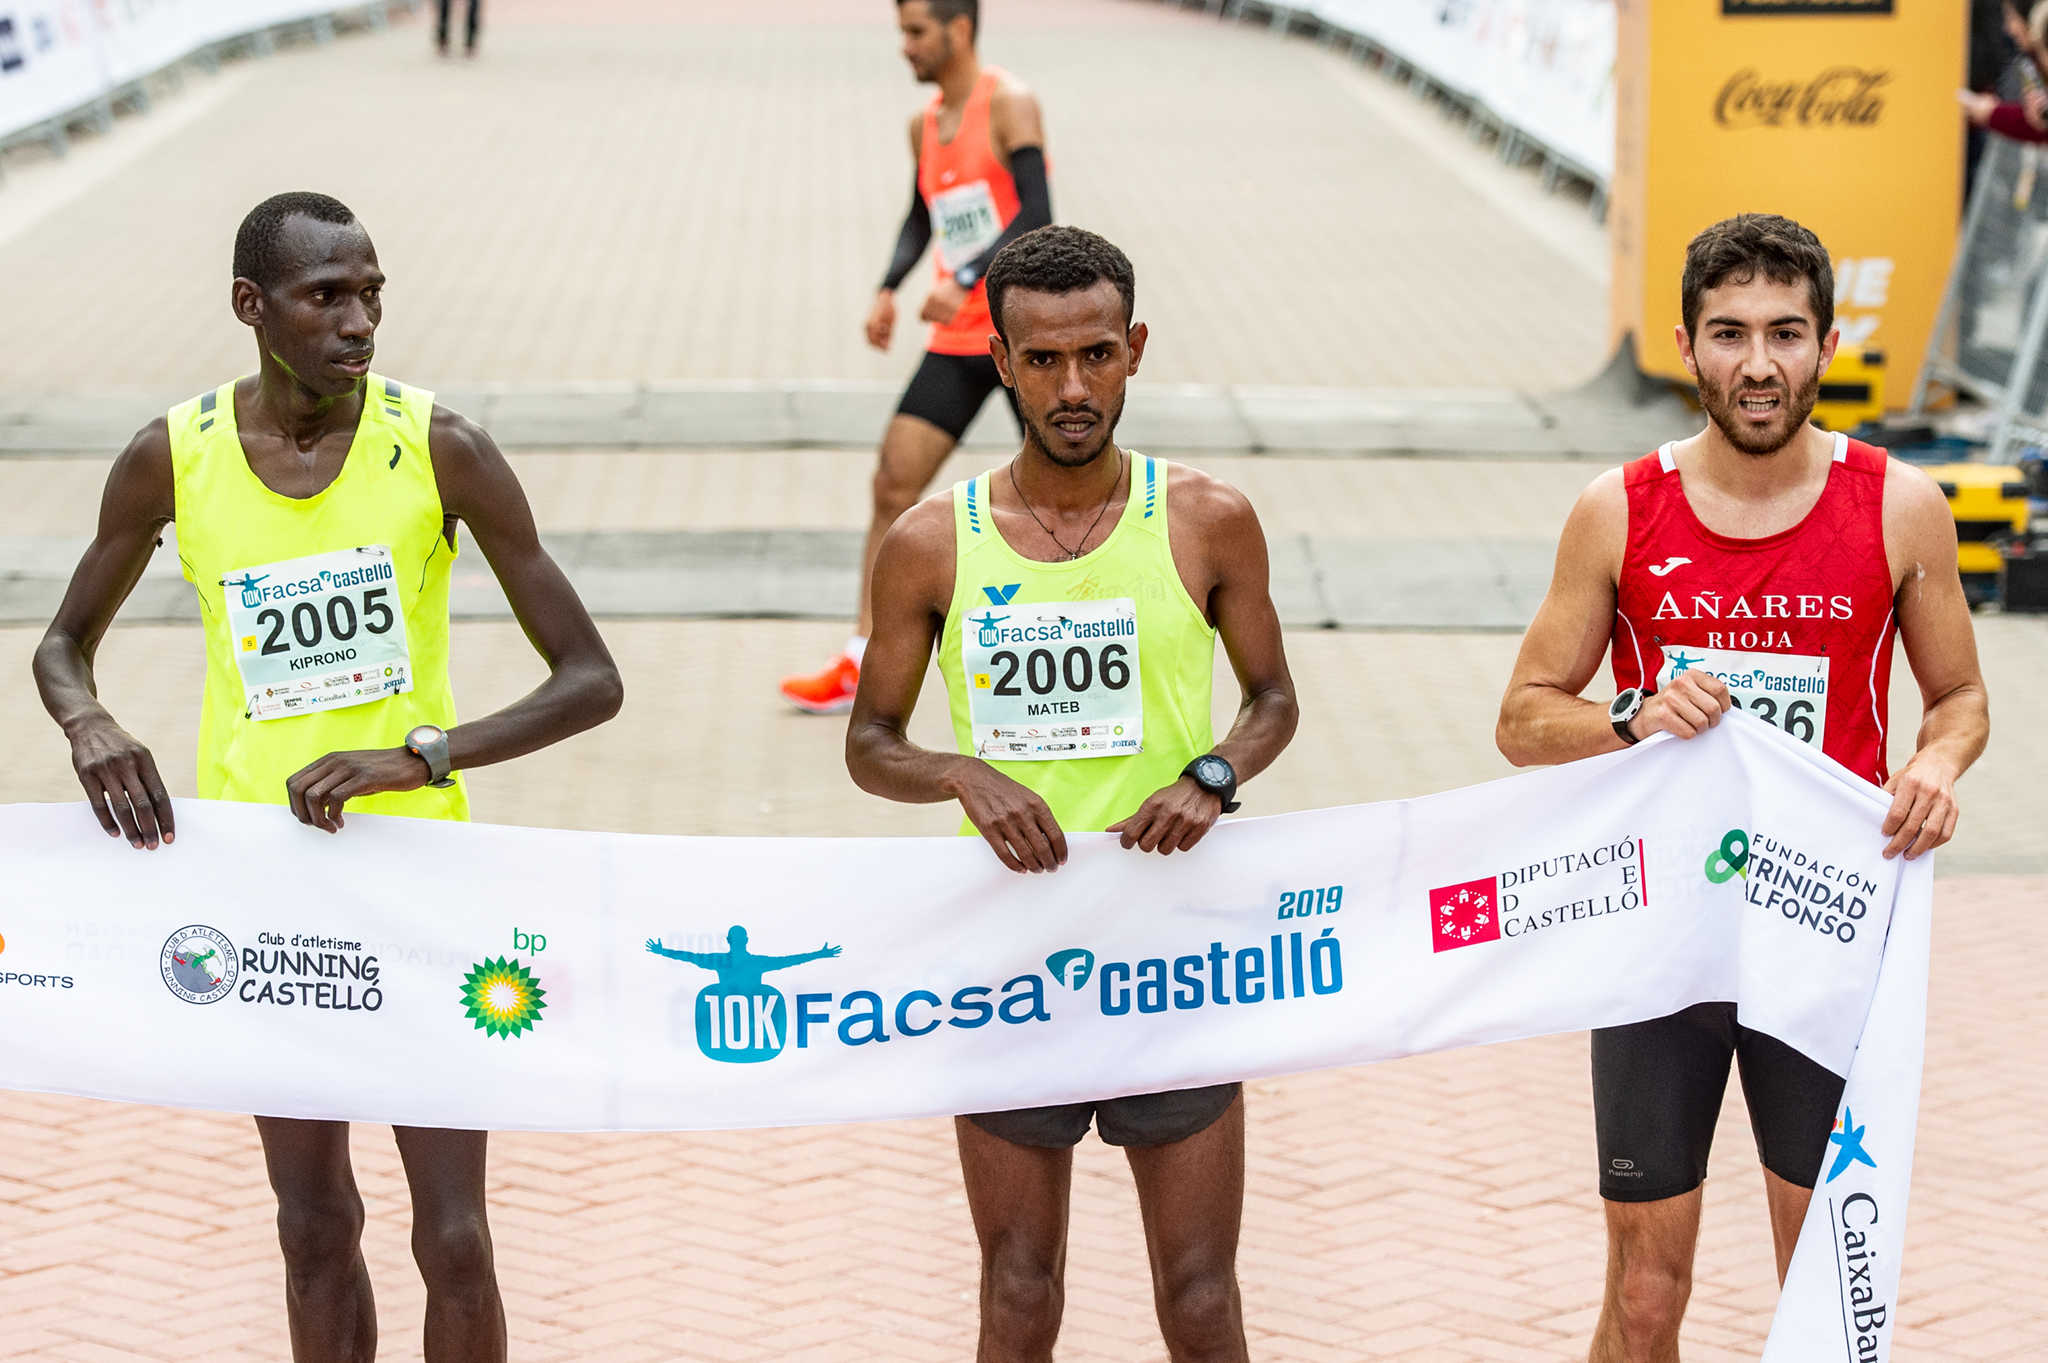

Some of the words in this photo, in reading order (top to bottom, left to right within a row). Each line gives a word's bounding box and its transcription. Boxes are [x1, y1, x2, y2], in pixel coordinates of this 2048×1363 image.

[243, 590, 259, 606] 10K
[262, 577, 322, 602] Facsa
[1651, 590, 1853, 620] AÑARES
[256, 588, 394, 657] 2005
[980, 629, 998, 645] 10K
[1001, 624, 1063, 644] Facsa
[1074, 617, 1135, 639] castelló
[1707, 631, 1793, 649] RIOJA
[289, 648, 357, 671] KIPRONO
[990, 643, 1131, 697] 2006
[1027, 701, 1081, 717] MATEB
[1501, 836, 1636, 890] DIPUTACIÓ
[1752, 833, 1877, 897] FUNDACIÓN
[1277, 885, 1344, 921] 2019
[1747, 852, 1867, 920] TRINIDAD
[1503, 892, 1639, 938] CASTELLÓ
[257, 931, 286, 946] Club
[290, 933, 363, 952] d'atletisme
[513, 927, 547, 957] bp
[242, 947, 380, 982] RUNNING
[239, 978, 383, 1012] CASTELLÓ
[704, 994, 782, 1050] 10K
[796, 974, 1051, 1049] Facsa
[1099, 926, 1344, 1018] castelló
